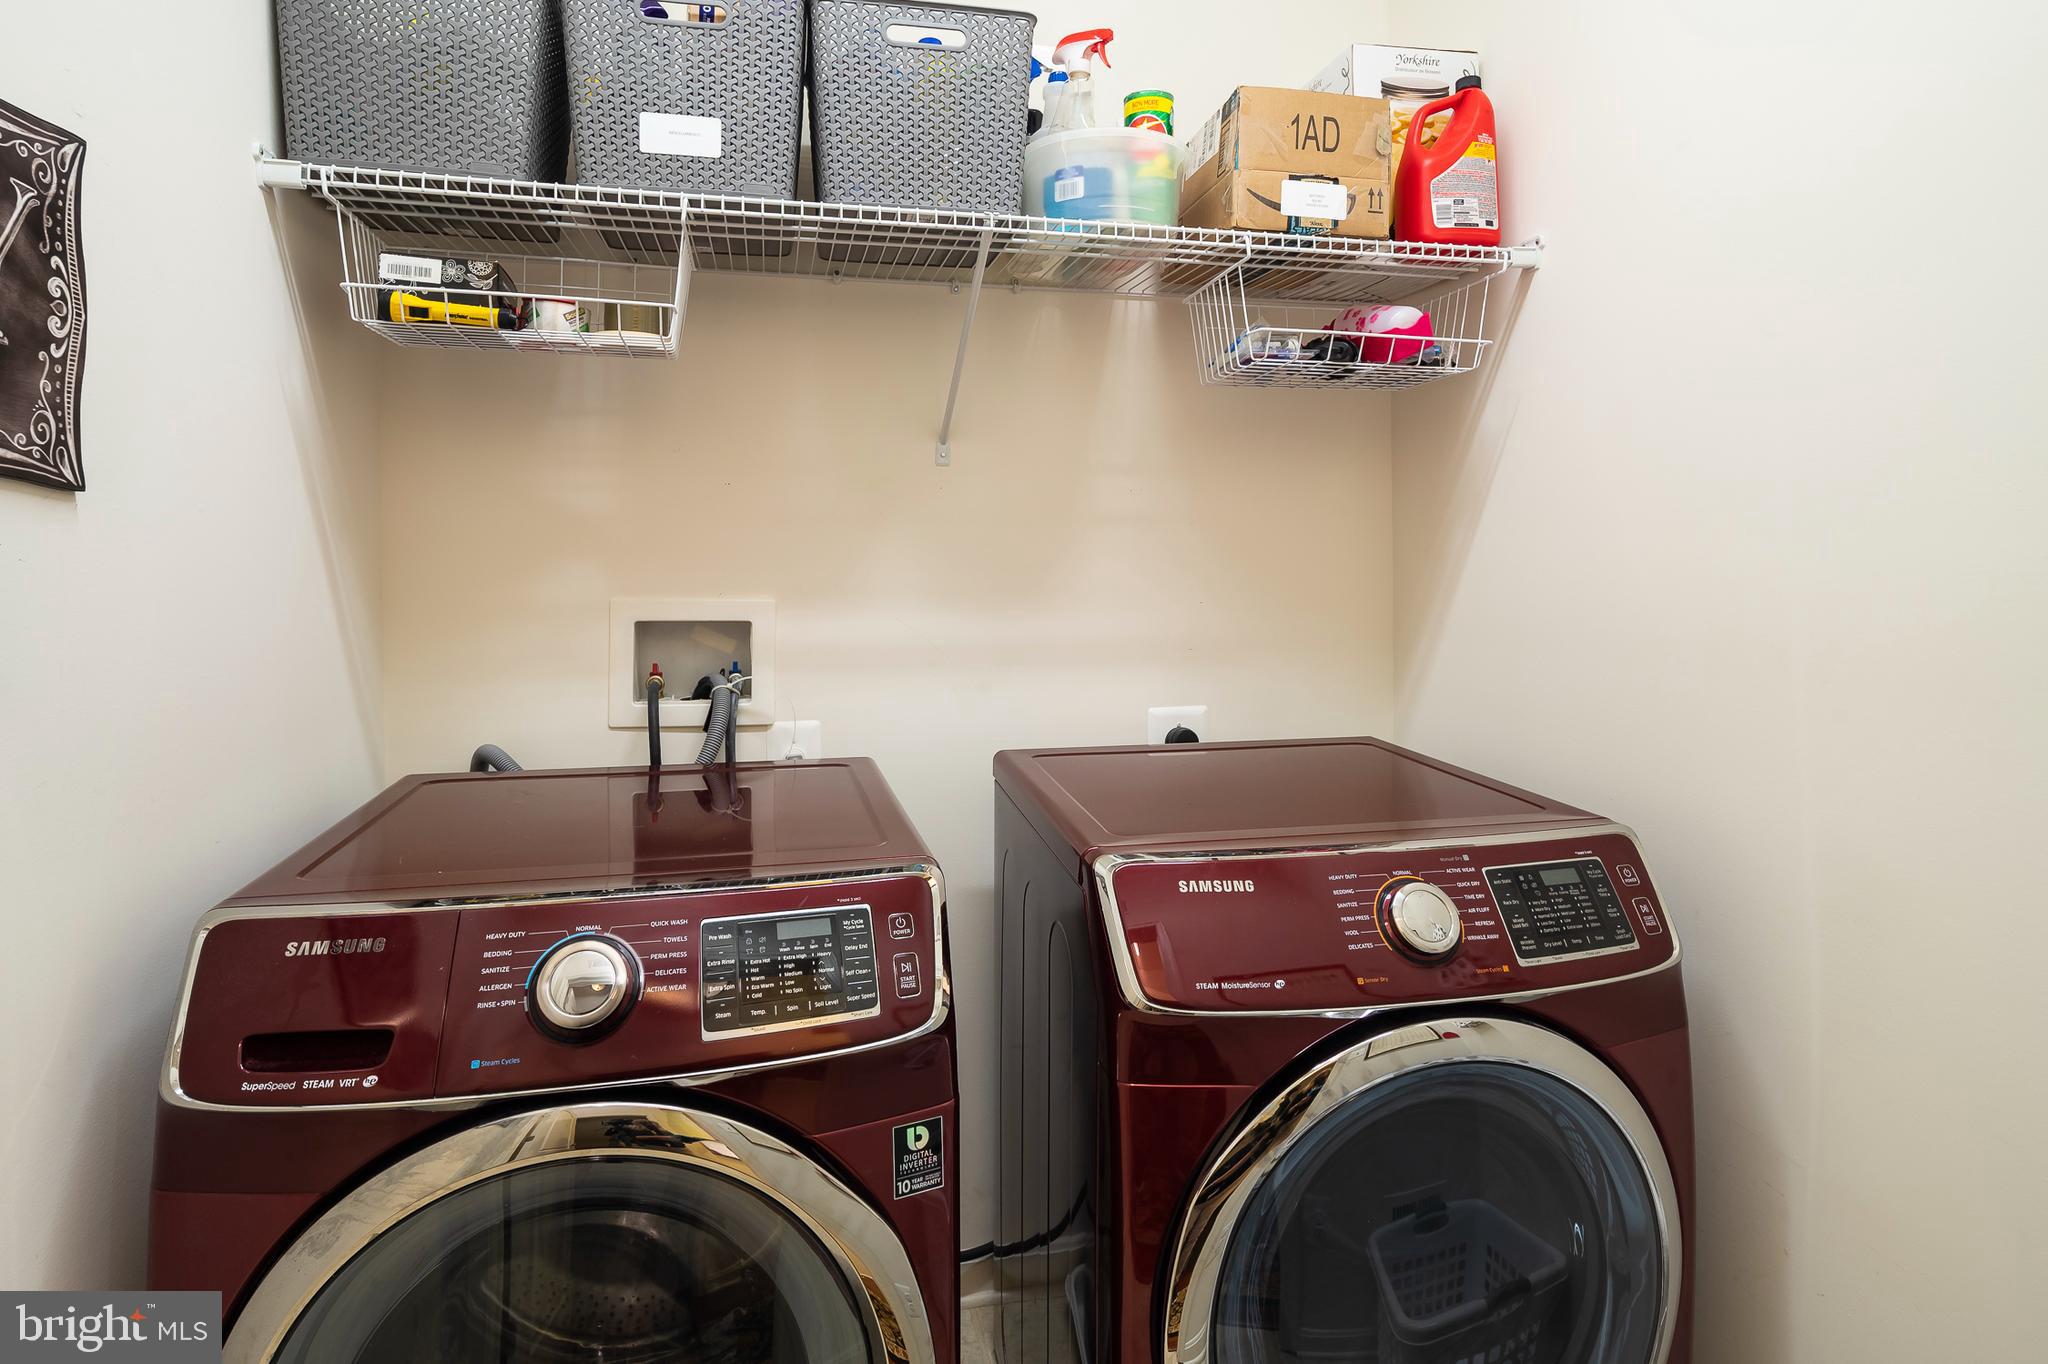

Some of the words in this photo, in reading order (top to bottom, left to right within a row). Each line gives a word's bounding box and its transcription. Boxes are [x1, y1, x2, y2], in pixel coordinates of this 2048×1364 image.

[1395, 54, 1440, 67] Yorkshire
[1291, 113, 1340, 152] 1AD
[1178, 880, 1255, 893] SAMSUNG
[285, 937, 386, 957] SAMSUNG
[483, 950, 512, 958] BEDDING
[481, 966, 510, 974] SANITIZE
[241, 1082, 296, 1092] SuperSpeed
[303, 1080, 334, 1089] STEAM
[904, 1149, 934, 1162] DIGITAL
[900, 1155, 938, 1171] INVERTER
[897, 1180, 910, 1194] 10
[912, 1178, 941, 1190] WARRANTY
